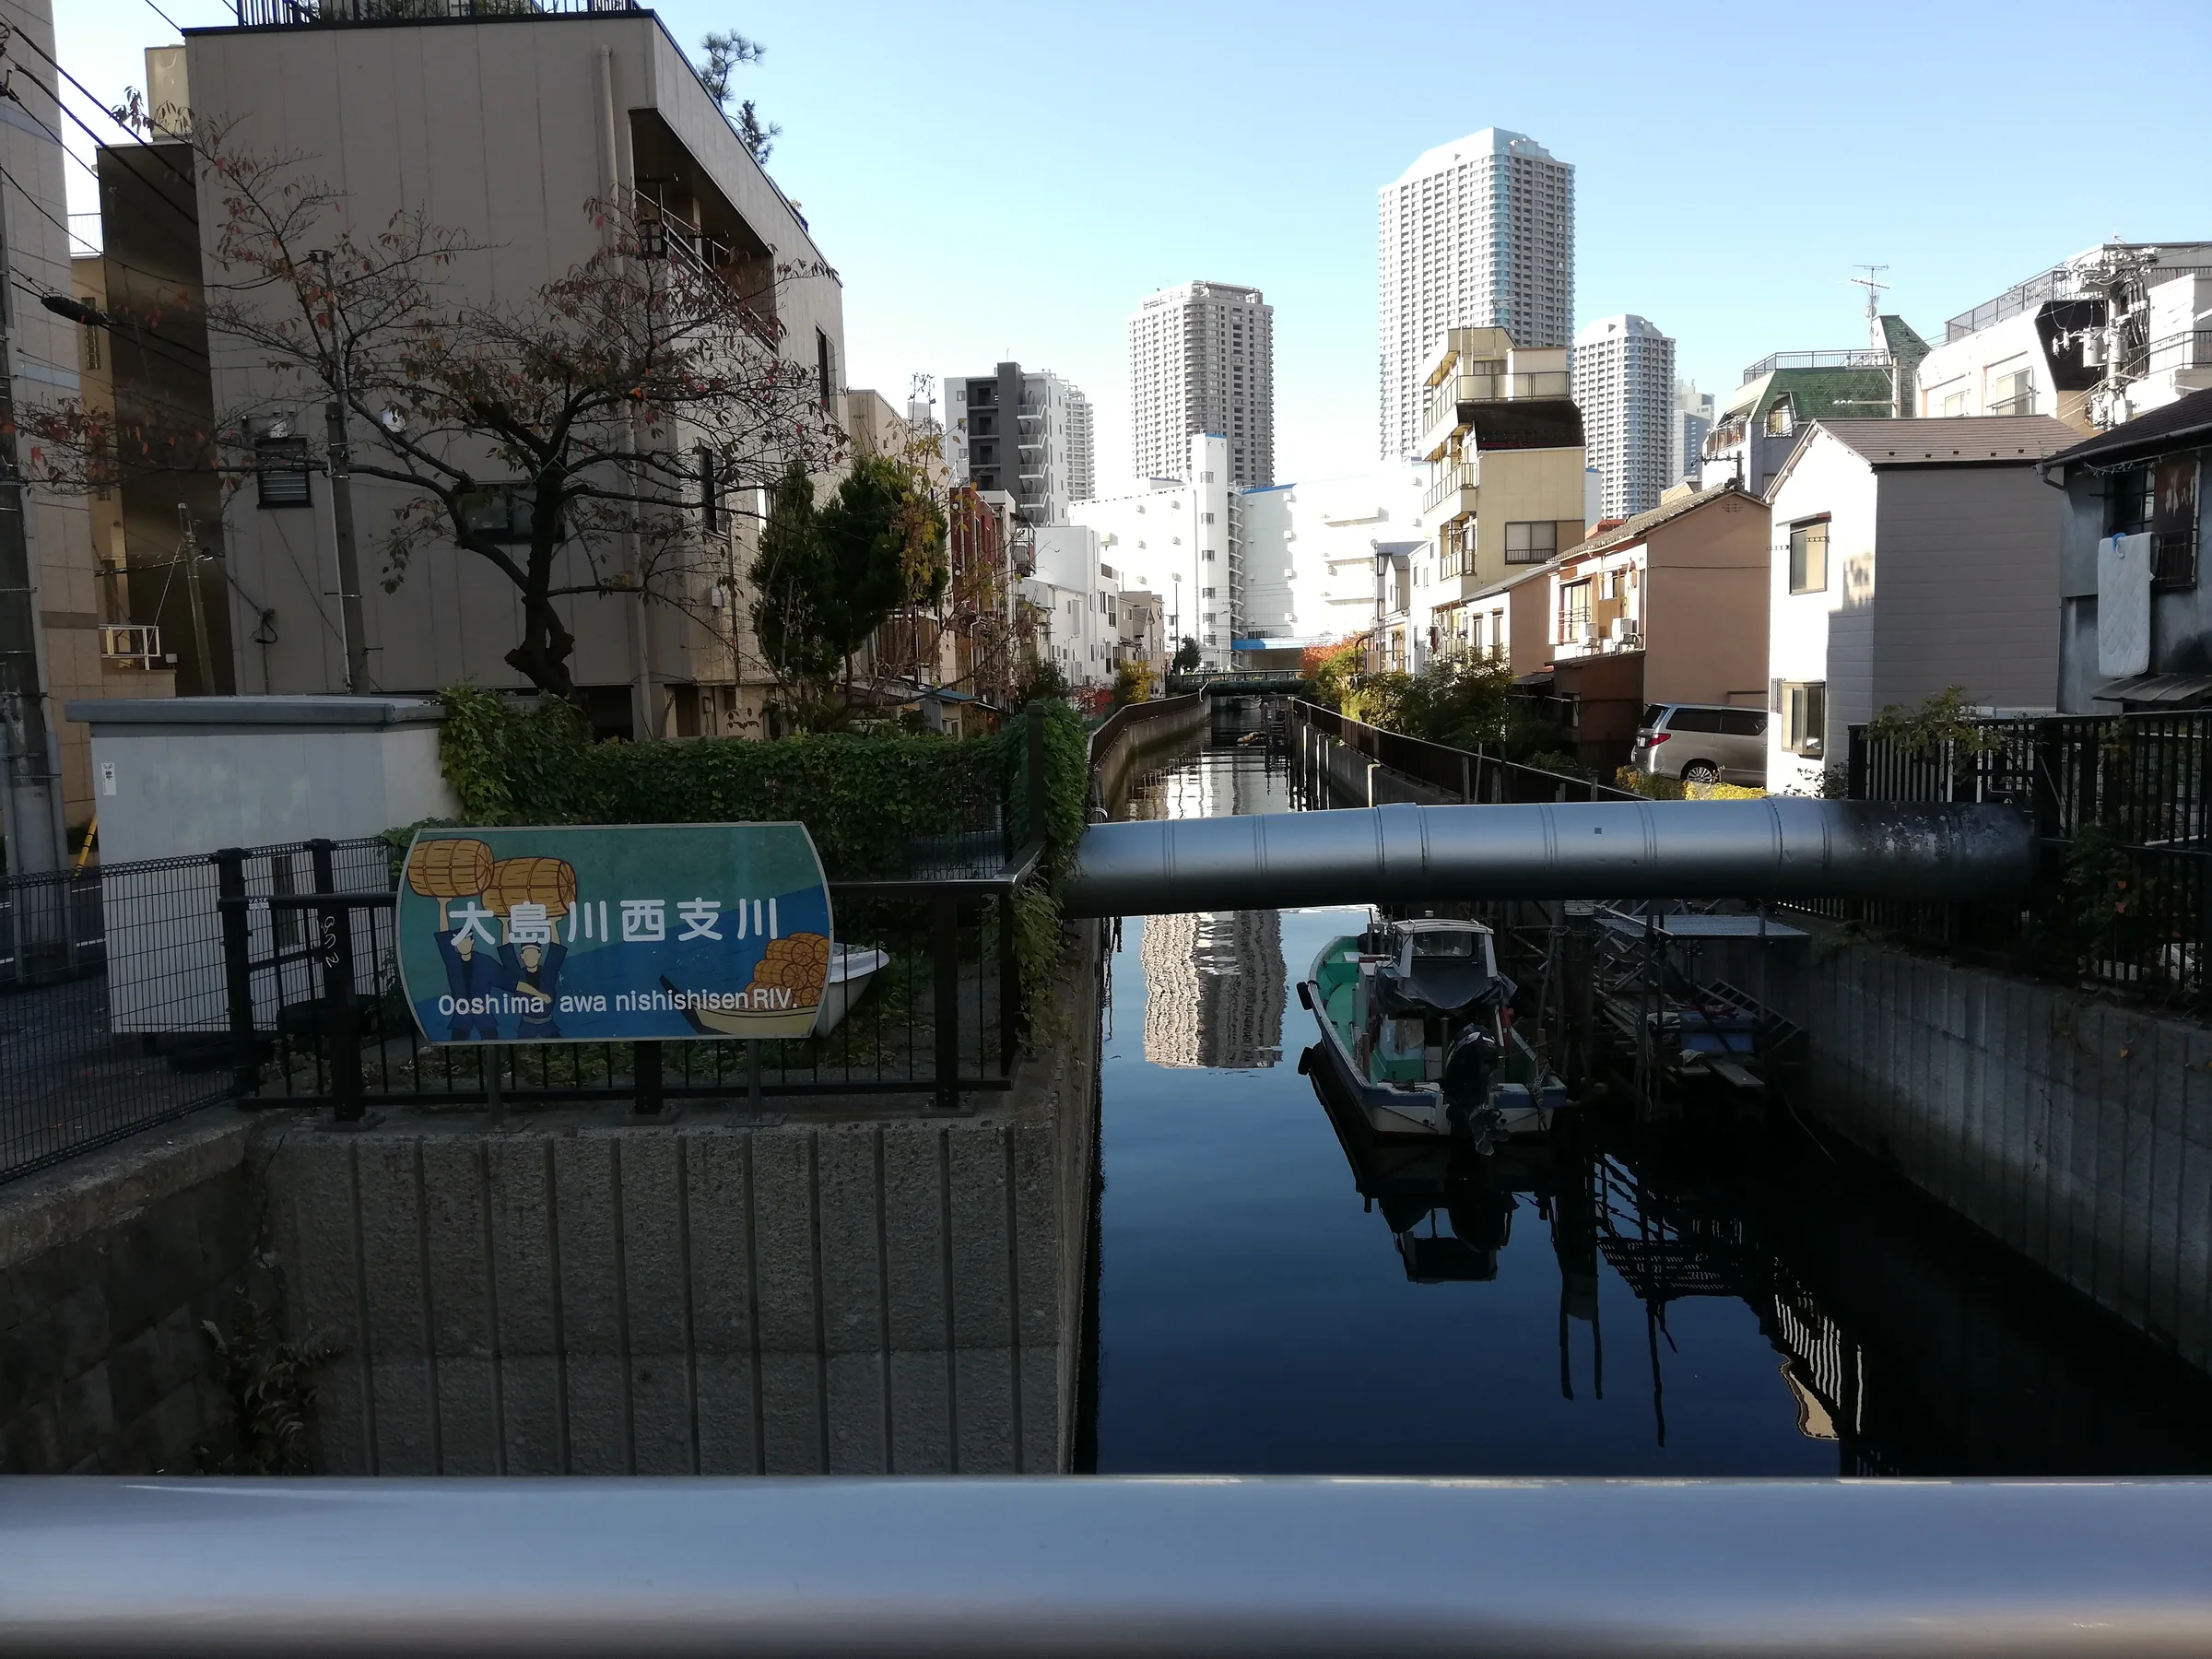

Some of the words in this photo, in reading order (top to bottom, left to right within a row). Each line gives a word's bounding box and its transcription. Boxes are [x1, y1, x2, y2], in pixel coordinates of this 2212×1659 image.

[449, 896, 779, 947] 大島川西支川
[438, 993, 545, 1016] Ooshima
[616, 988, 749, 1012] nishishisen
[752, 987, 798, 1009] RIV.
